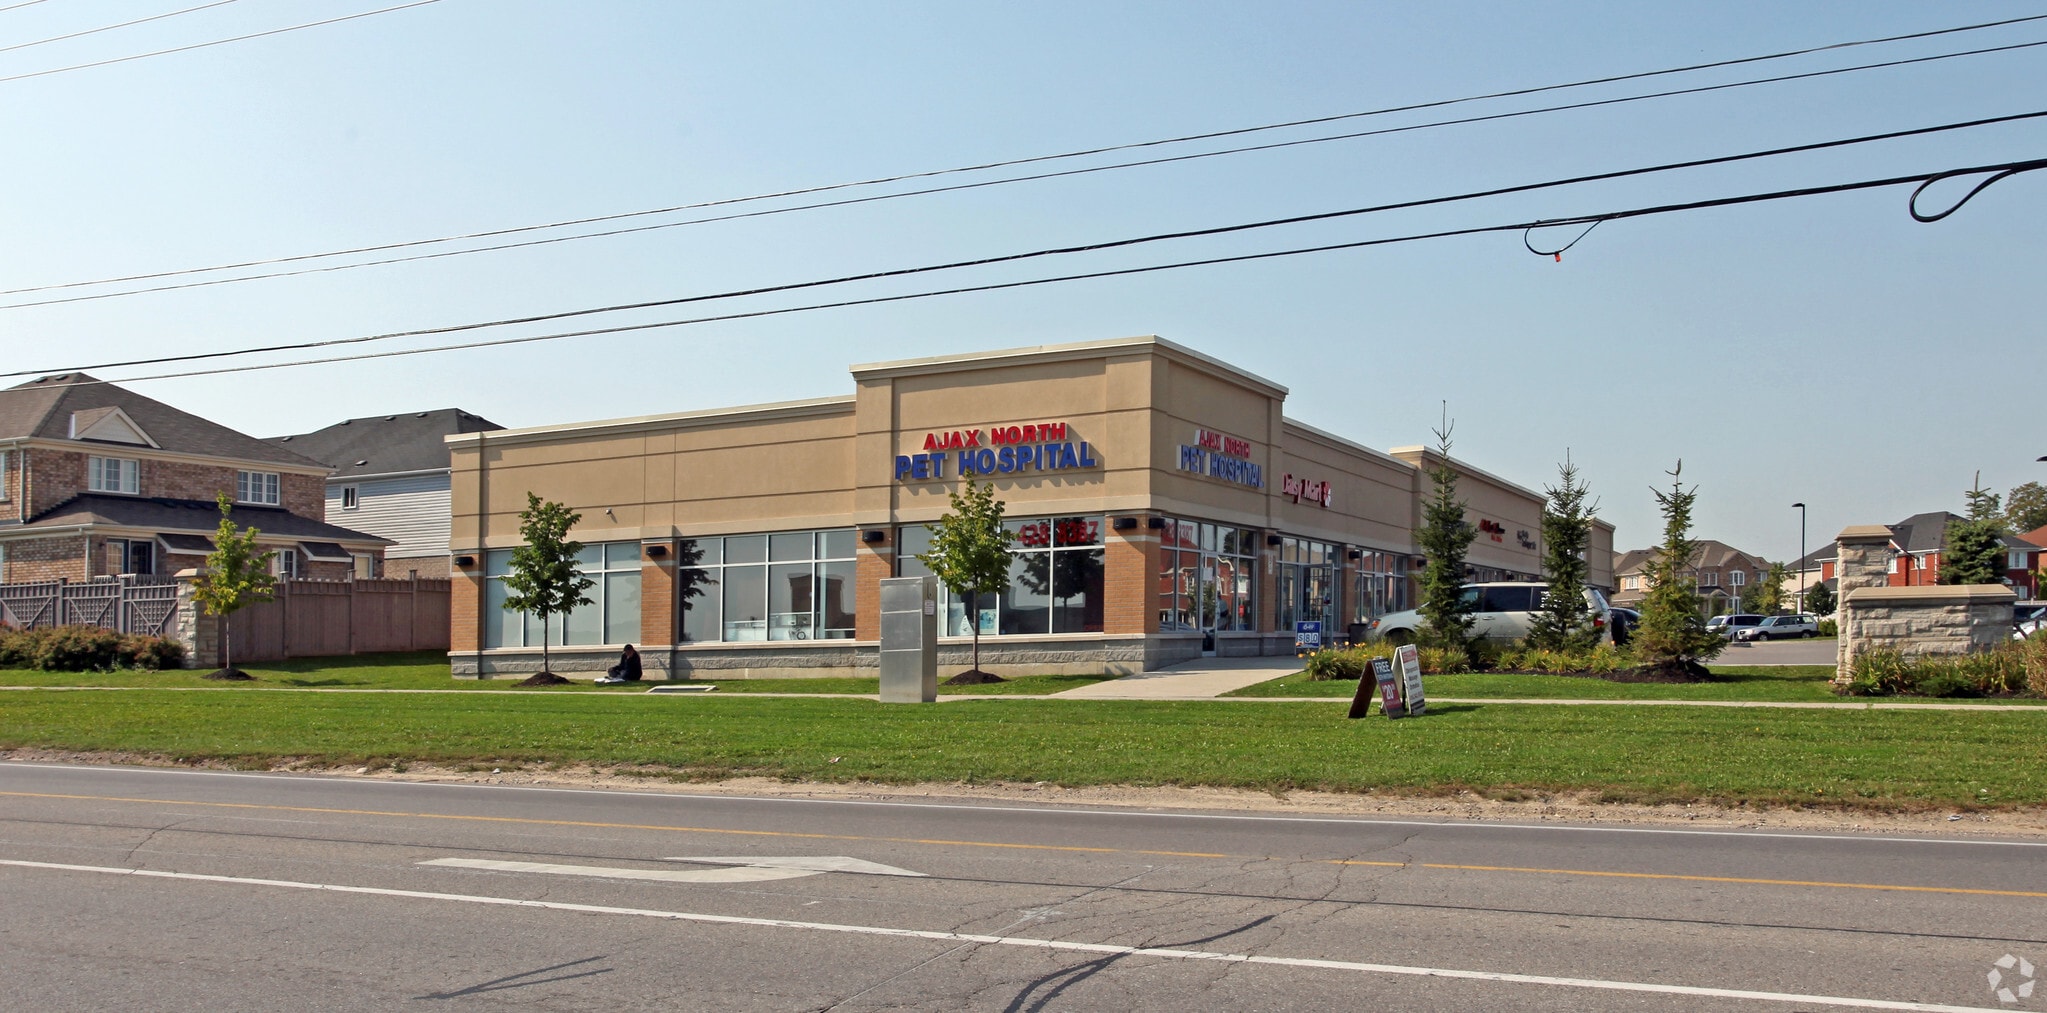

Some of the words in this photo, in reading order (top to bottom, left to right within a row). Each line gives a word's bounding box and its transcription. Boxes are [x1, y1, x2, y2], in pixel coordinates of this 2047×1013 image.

[923, 429, 982, 450] AJAX
[991, 422, 1067, 445] NORTH
[1196, 429, 1222, 450] AJAX
[1223, 436, 1250, 458] NORTH
[895, 452, 948, 480] PET
[958, 441, 1098, 475] HOSPITAL
[1178, 444, 1206, 474] PET
[1207, 453, 1264, 488] HOSPITAL
[1282, 472, 1301, 504] Daisy
[1303, 479, 1321, 502] Mart
[1374, 661, 1391, 674] FREE
